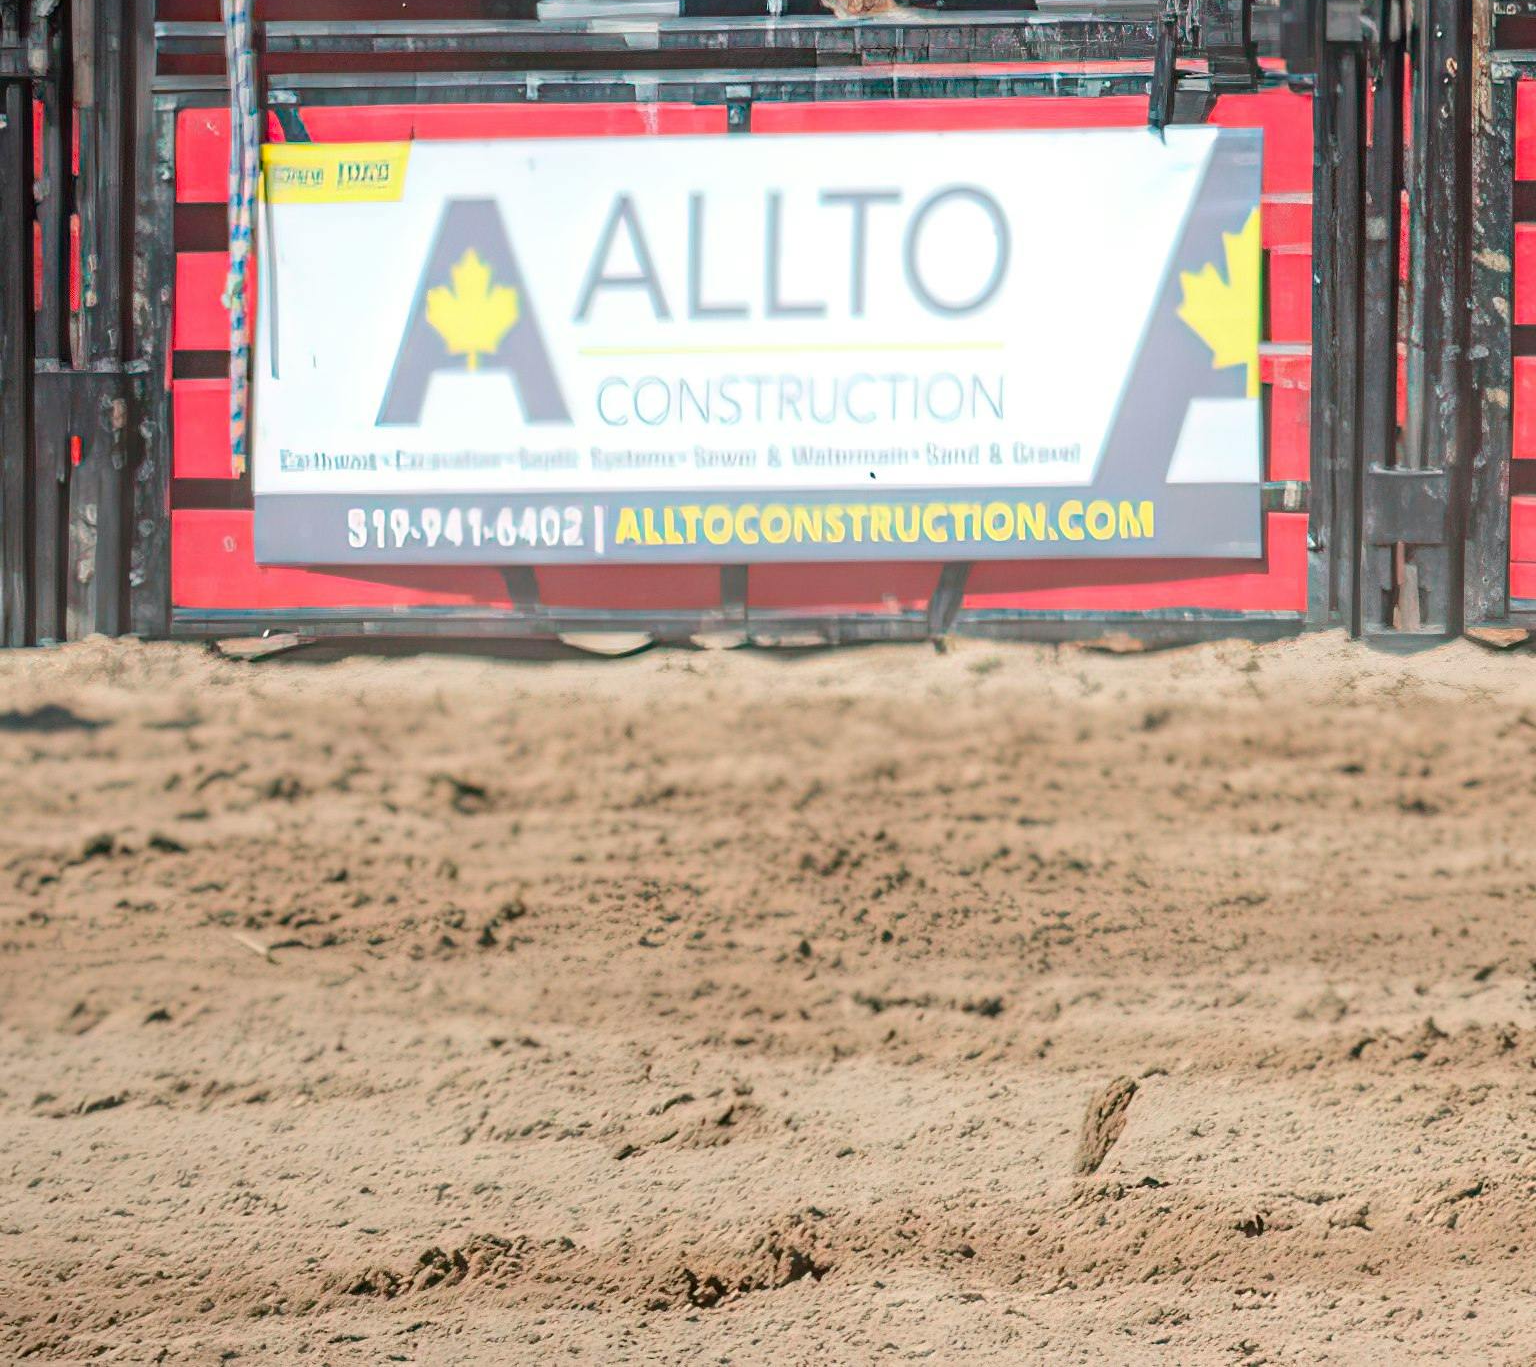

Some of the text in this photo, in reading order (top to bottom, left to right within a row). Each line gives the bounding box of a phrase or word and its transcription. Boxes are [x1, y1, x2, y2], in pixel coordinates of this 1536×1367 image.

[573, 185, 1012, 326] ALLTO
[596, 371, 1007, 426] CONSTRUCTION
[615, 499, 1155, 546] ALLTOCONSTRUCTION.COM
